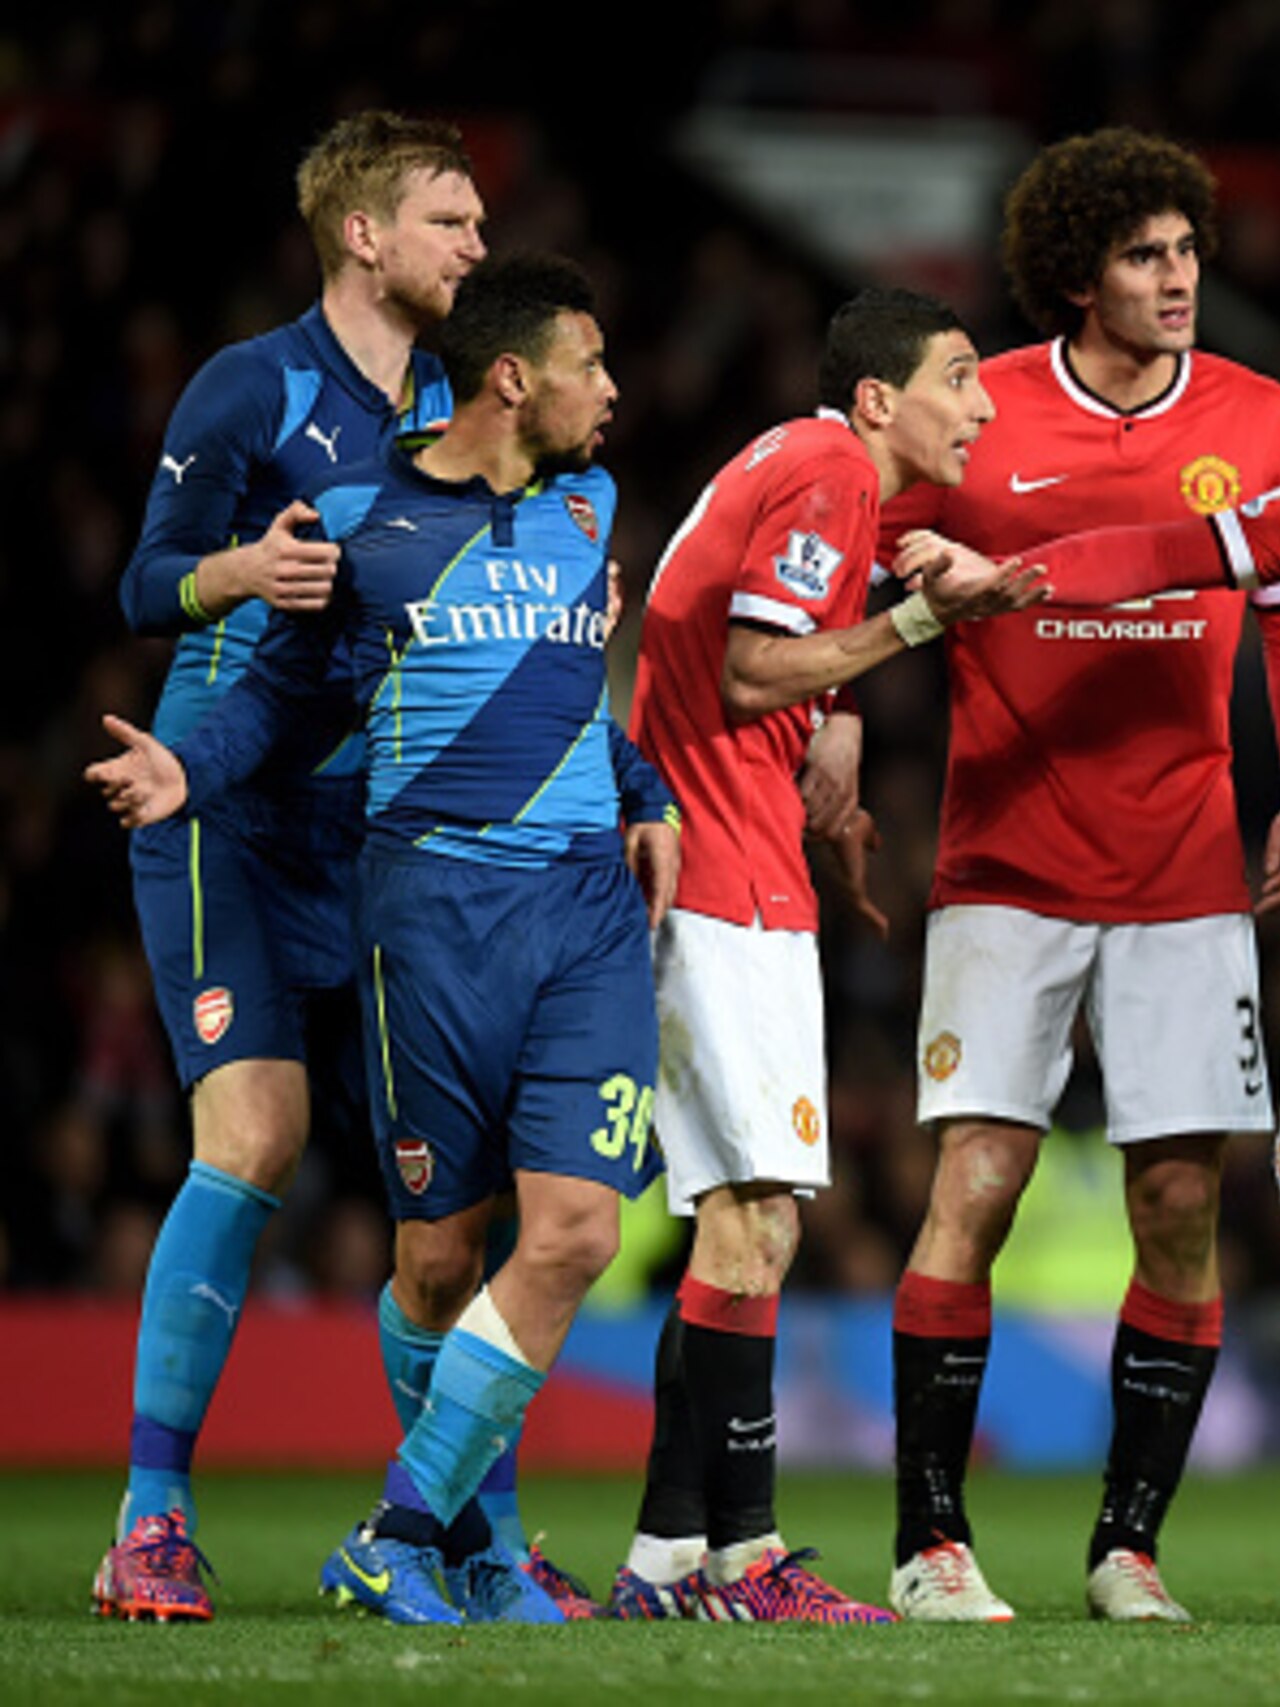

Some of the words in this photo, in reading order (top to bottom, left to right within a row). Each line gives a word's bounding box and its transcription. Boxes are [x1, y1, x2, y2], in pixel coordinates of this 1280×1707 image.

[485, 559, 558, 598] Fly
[404, 593, 605, 650] Emirate
[1036, 619, 1208, 640] CHEVROLET
[1236, 995, 1259, 1071] 3
